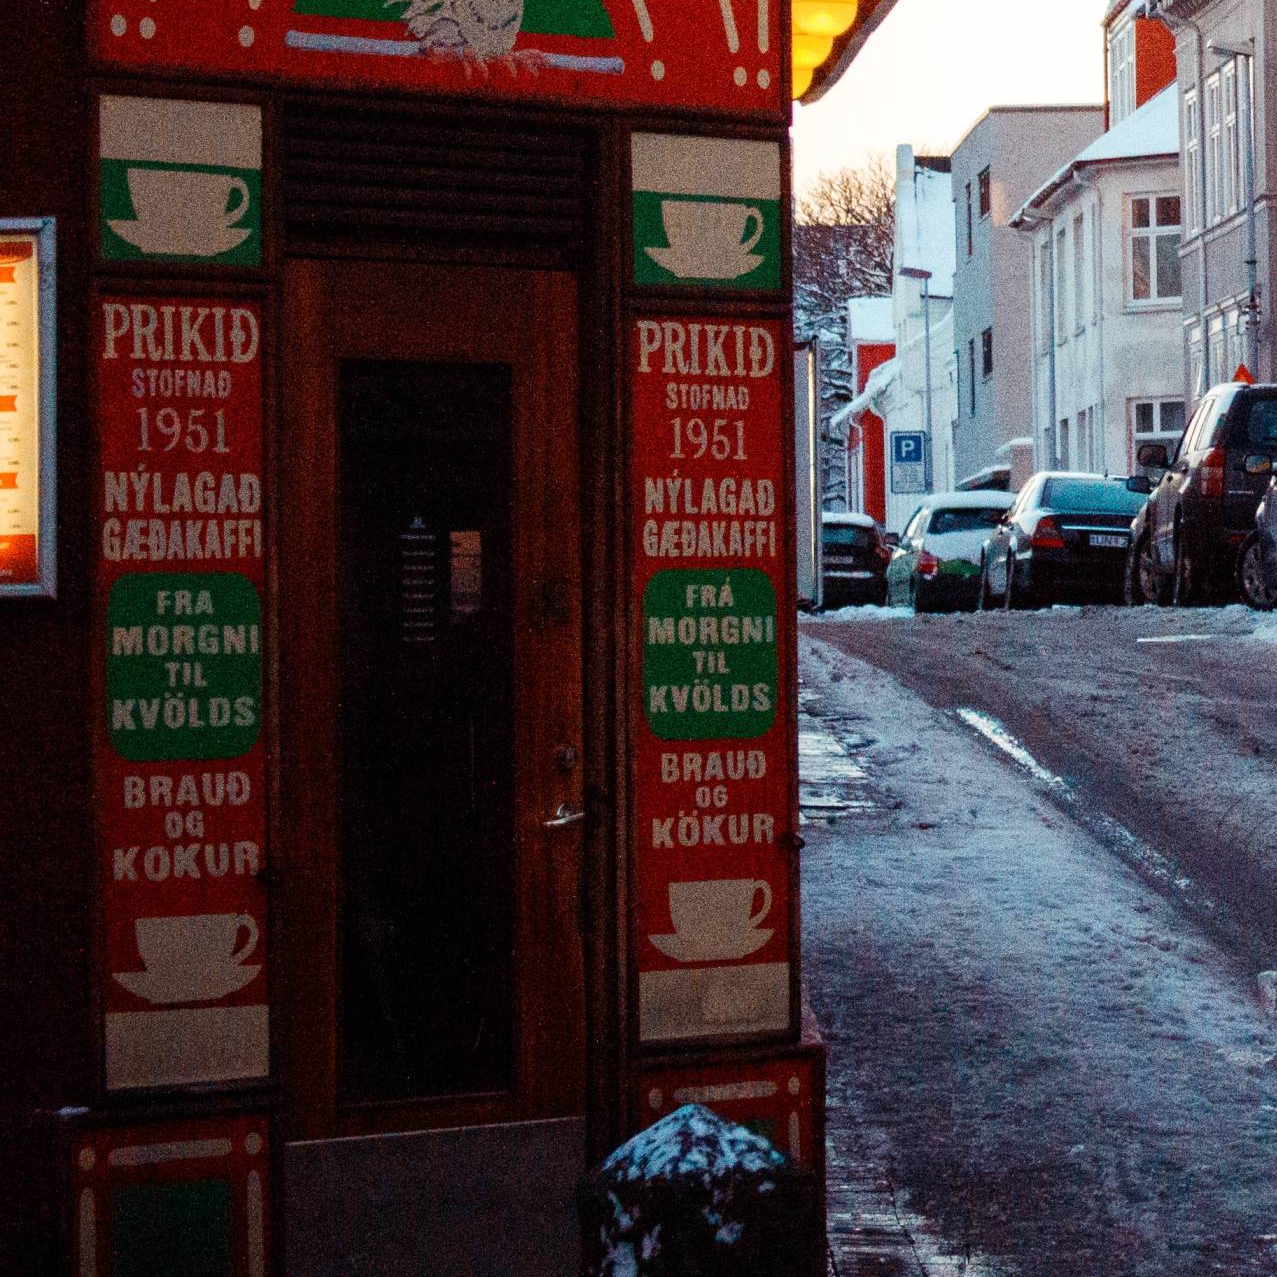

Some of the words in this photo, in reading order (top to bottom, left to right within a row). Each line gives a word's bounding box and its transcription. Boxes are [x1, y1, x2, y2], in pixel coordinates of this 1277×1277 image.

[102, 303, 260, 364] PRIKIÐ
[636, 320, 776, 379] PRIKIÐ
[136, 407, 230, 453] 1951
[670, 417, 748, 460] 1951
[901, 440, 915, 458] P
[104, 462, 262, 514] NÝLAGAÐ
[644, 468, 776, 517] NÝLAGAÐ
[102, 517, 263, 562] GÆÐAKAFFI
[642, 520, 776, 558] GÆÐAKAFFI
[685, 576, 735, 608] FRÁ
[111, 624, 260, 656] MORGNI
[648, 615, 774, 645] MORGNI
[164, 660, 208, 688] TIL
[691, 650, 731, 675] TIL
[111, 692, 256, 730] KVÖLDS
[648, 678, 772, 713] KVÖLDS
[123, 771, 251, 809] BRAUÐ
[695, 784, 729, 809] OG
[164, 810, 205, 839] OG
[652, 809, 776, 849] KÖKUR
